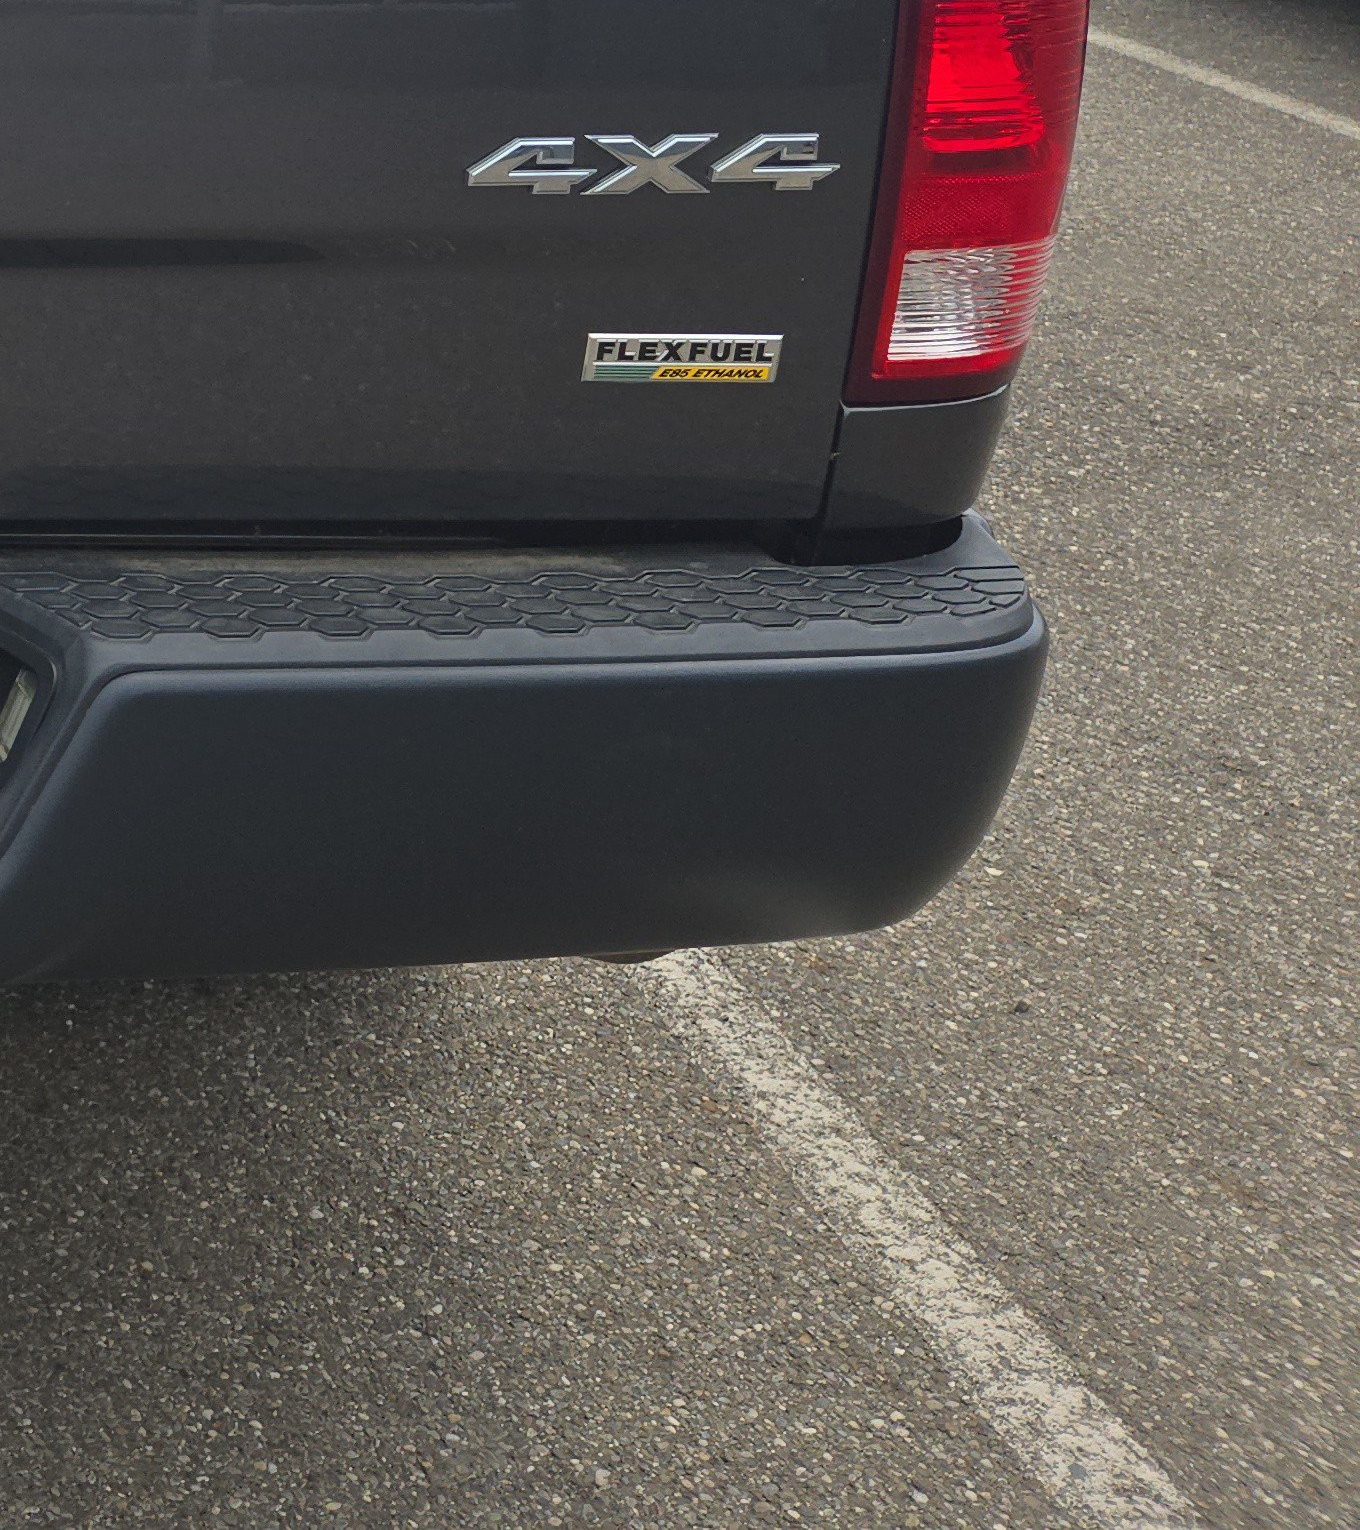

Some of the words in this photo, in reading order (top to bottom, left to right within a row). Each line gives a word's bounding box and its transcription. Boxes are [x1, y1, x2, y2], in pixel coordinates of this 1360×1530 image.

[465, 132, 841, 196] 4X4
[595, 338, 775, 362] FLEXFUEL
[658, 367, 690, 379] E85
[691, 367, 764, 379] ETHANOL
